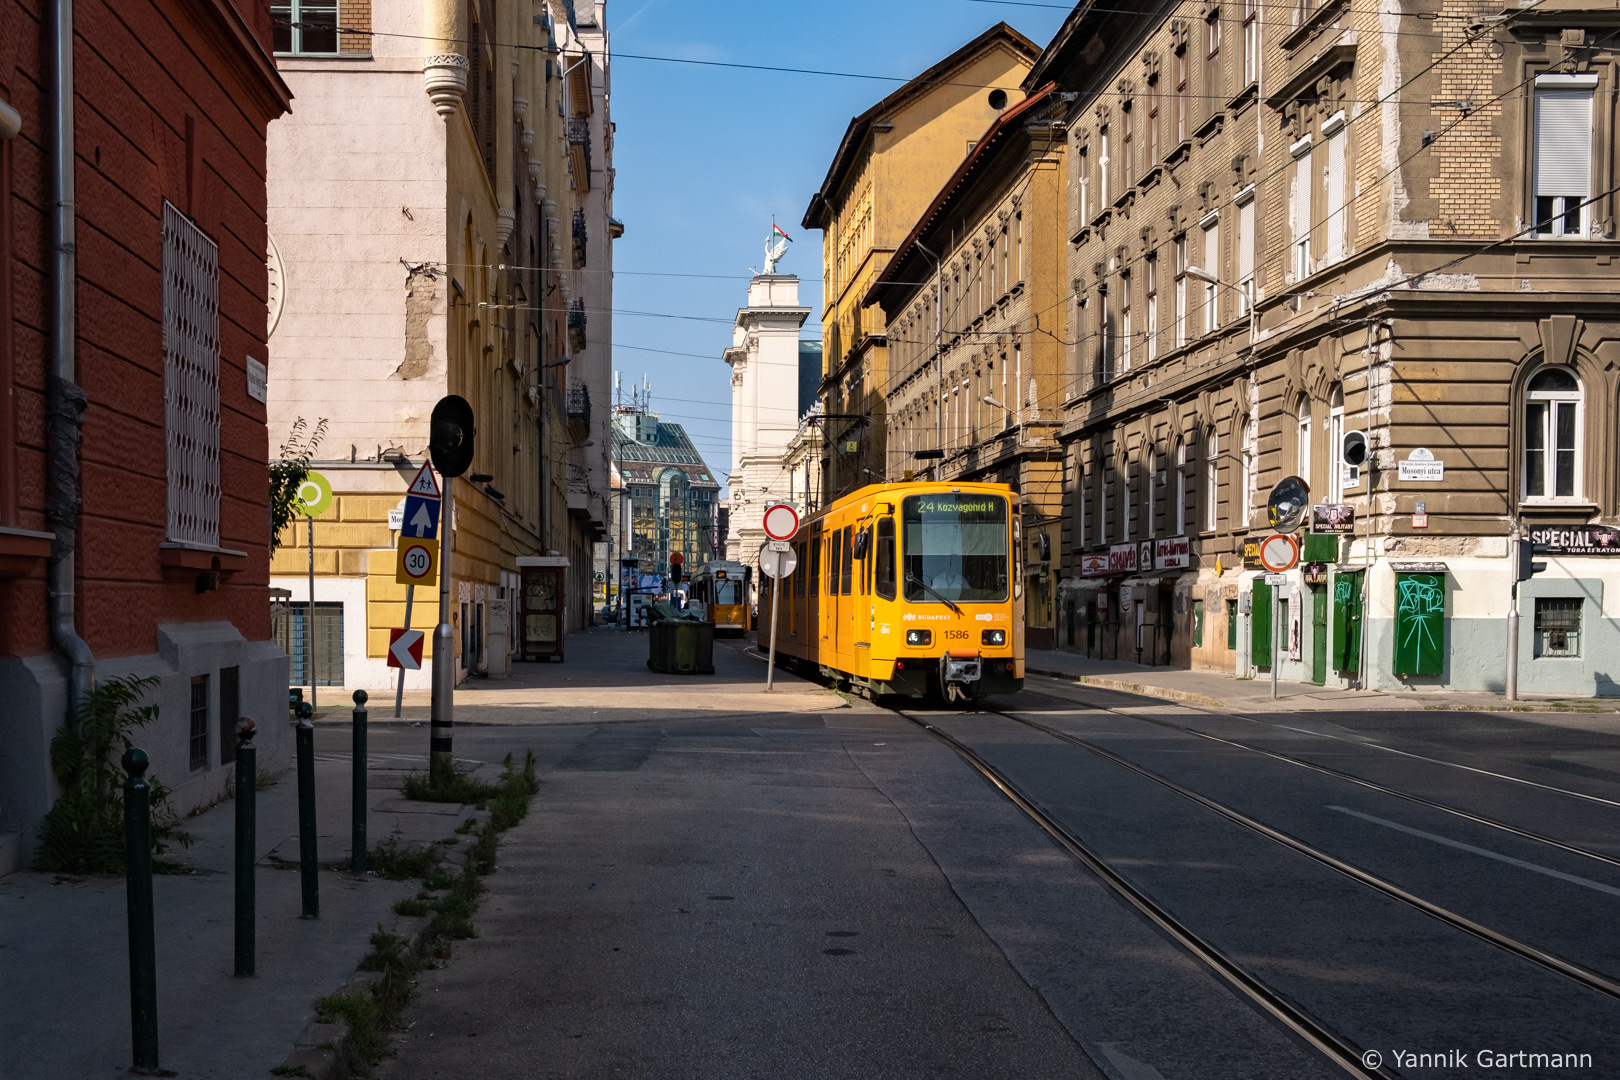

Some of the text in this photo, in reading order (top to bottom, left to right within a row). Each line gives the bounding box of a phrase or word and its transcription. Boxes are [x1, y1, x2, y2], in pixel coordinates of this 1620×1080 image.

[1402, 466, 1441, 476] Mosonyi utca
[918, 502, 935, 513] 24
[988, 502, 994, 512] H
[1532, 530, 1594, 547] SPECIAL
[409, 553, 425, 569] 30
[944, 630, 969, 640] 1586
